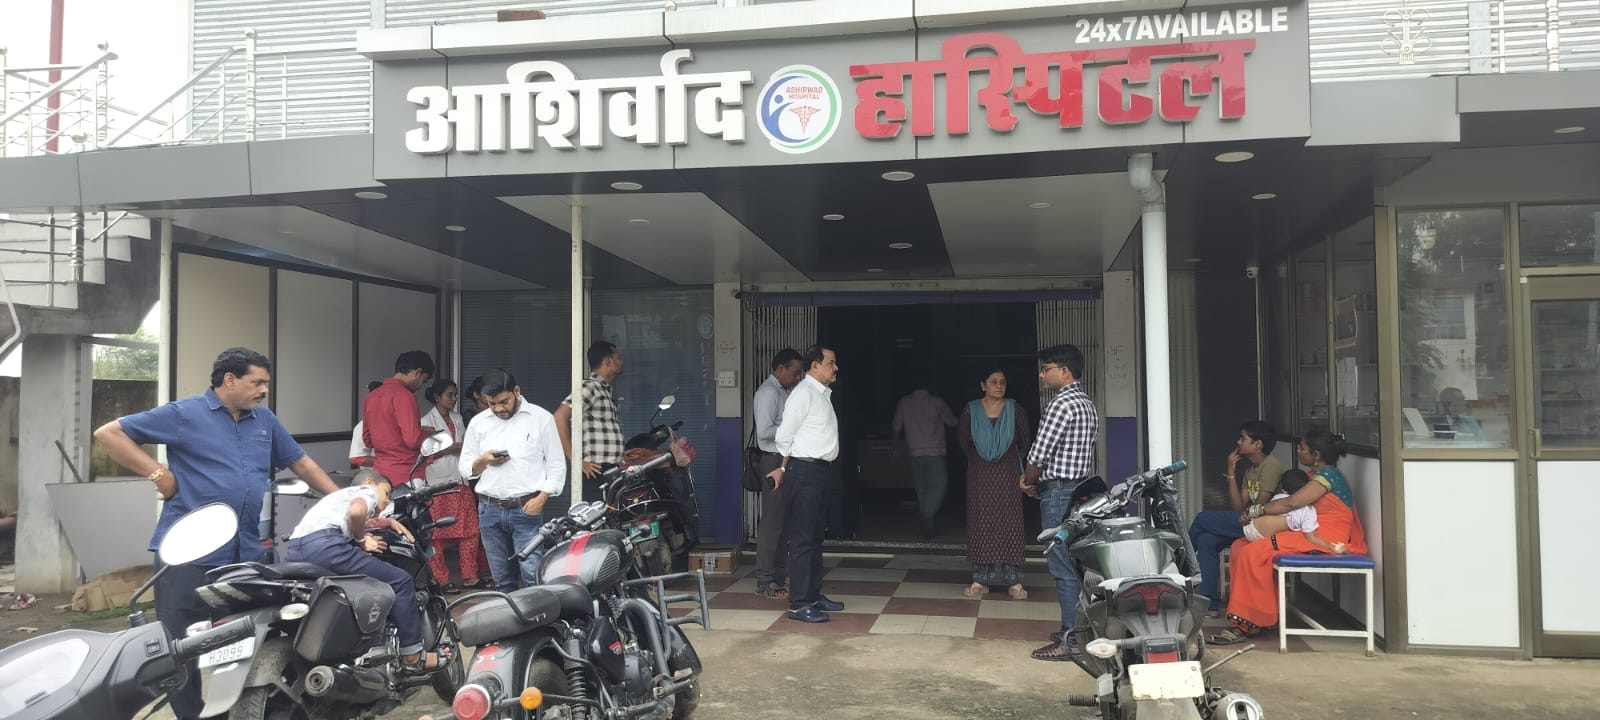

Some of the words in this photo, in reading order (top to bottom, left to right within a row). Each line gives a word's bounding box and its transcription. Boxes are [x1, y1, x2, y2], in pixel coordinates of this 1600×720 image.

[405, 49, 753, 154] आशिर्वाद
[849, 32, 1257, 139] हास्पिटल
[786, 86, 823, 94] ASHIRWAD
